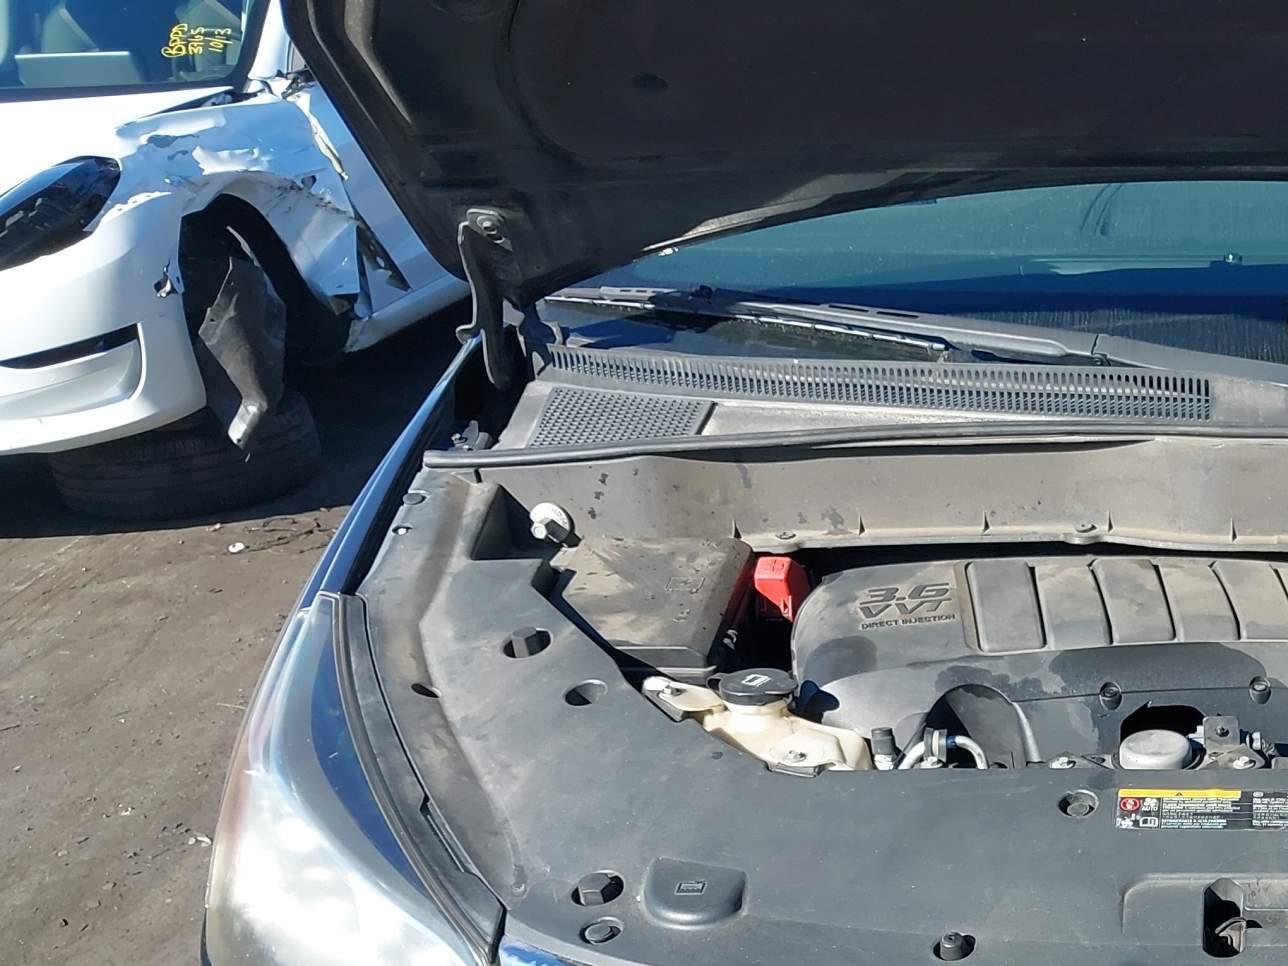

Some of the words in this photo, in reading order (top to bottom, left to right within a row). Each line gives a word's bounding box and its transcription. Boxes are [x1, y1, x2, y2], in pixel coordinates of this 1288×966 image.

[859, 582, 950, 605] 3.6
[859, 598, 952, 618] VVT
[860, 619, 900, 631] DIRECT
[901, 614, 957, 626] INJECTION
